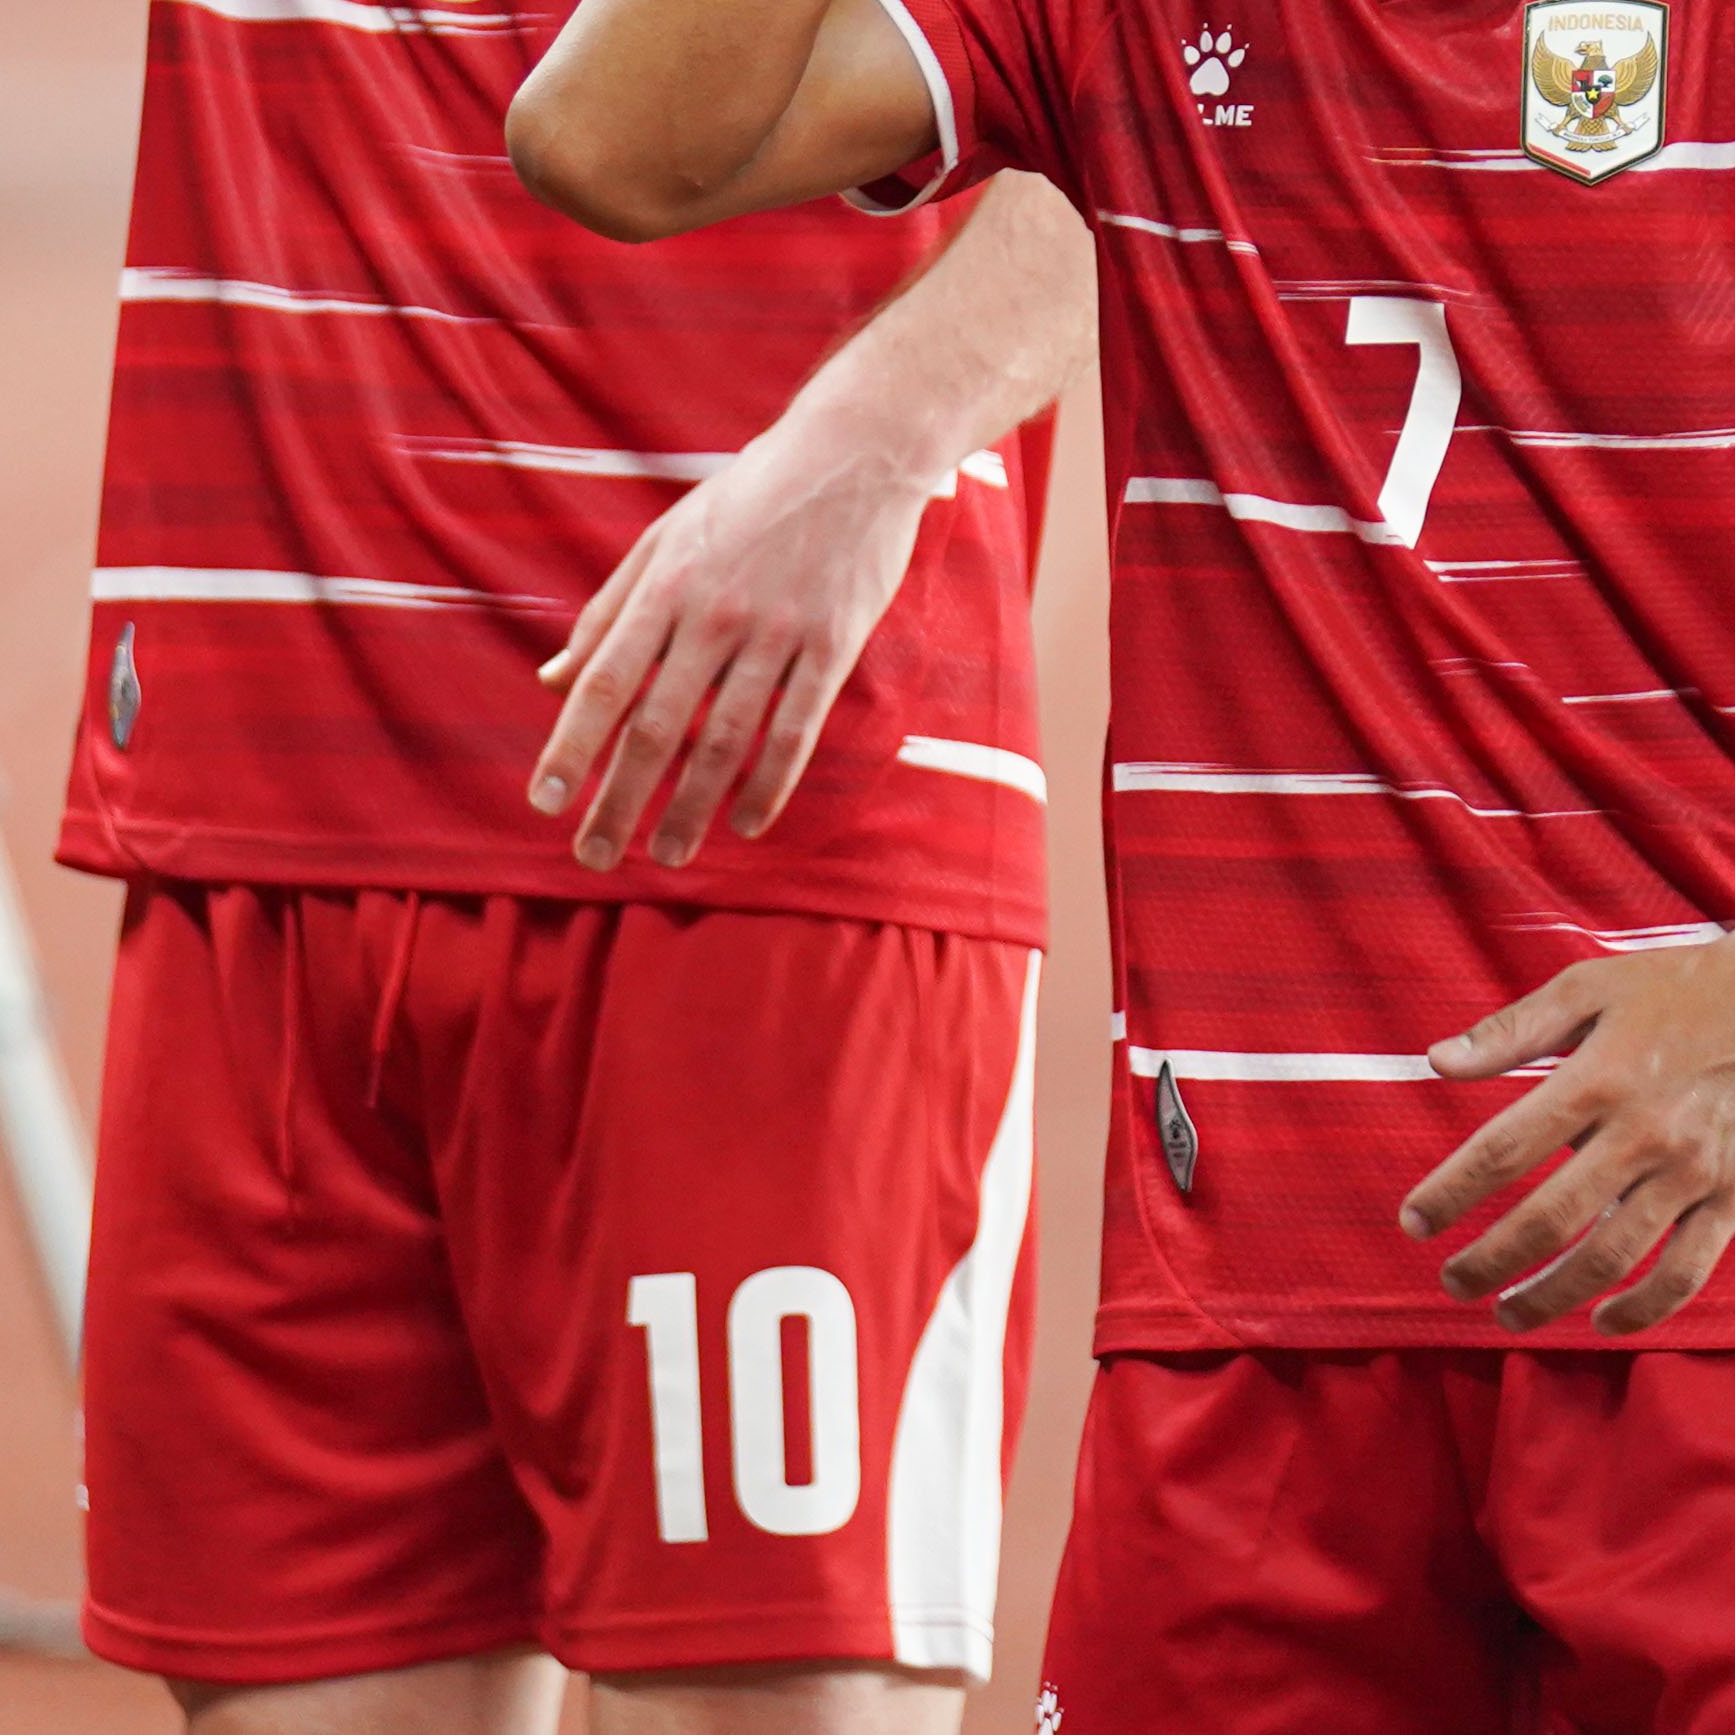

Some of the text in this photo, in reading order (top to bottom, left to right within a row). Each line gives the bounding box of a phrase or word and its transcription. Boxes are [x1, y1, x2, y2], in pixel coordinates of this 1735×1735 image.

[1547, 13, 1644, 32] INDONESIA
[1345, 296, 1462, 549] 7
[626, 1265, 861, 1543] 10
